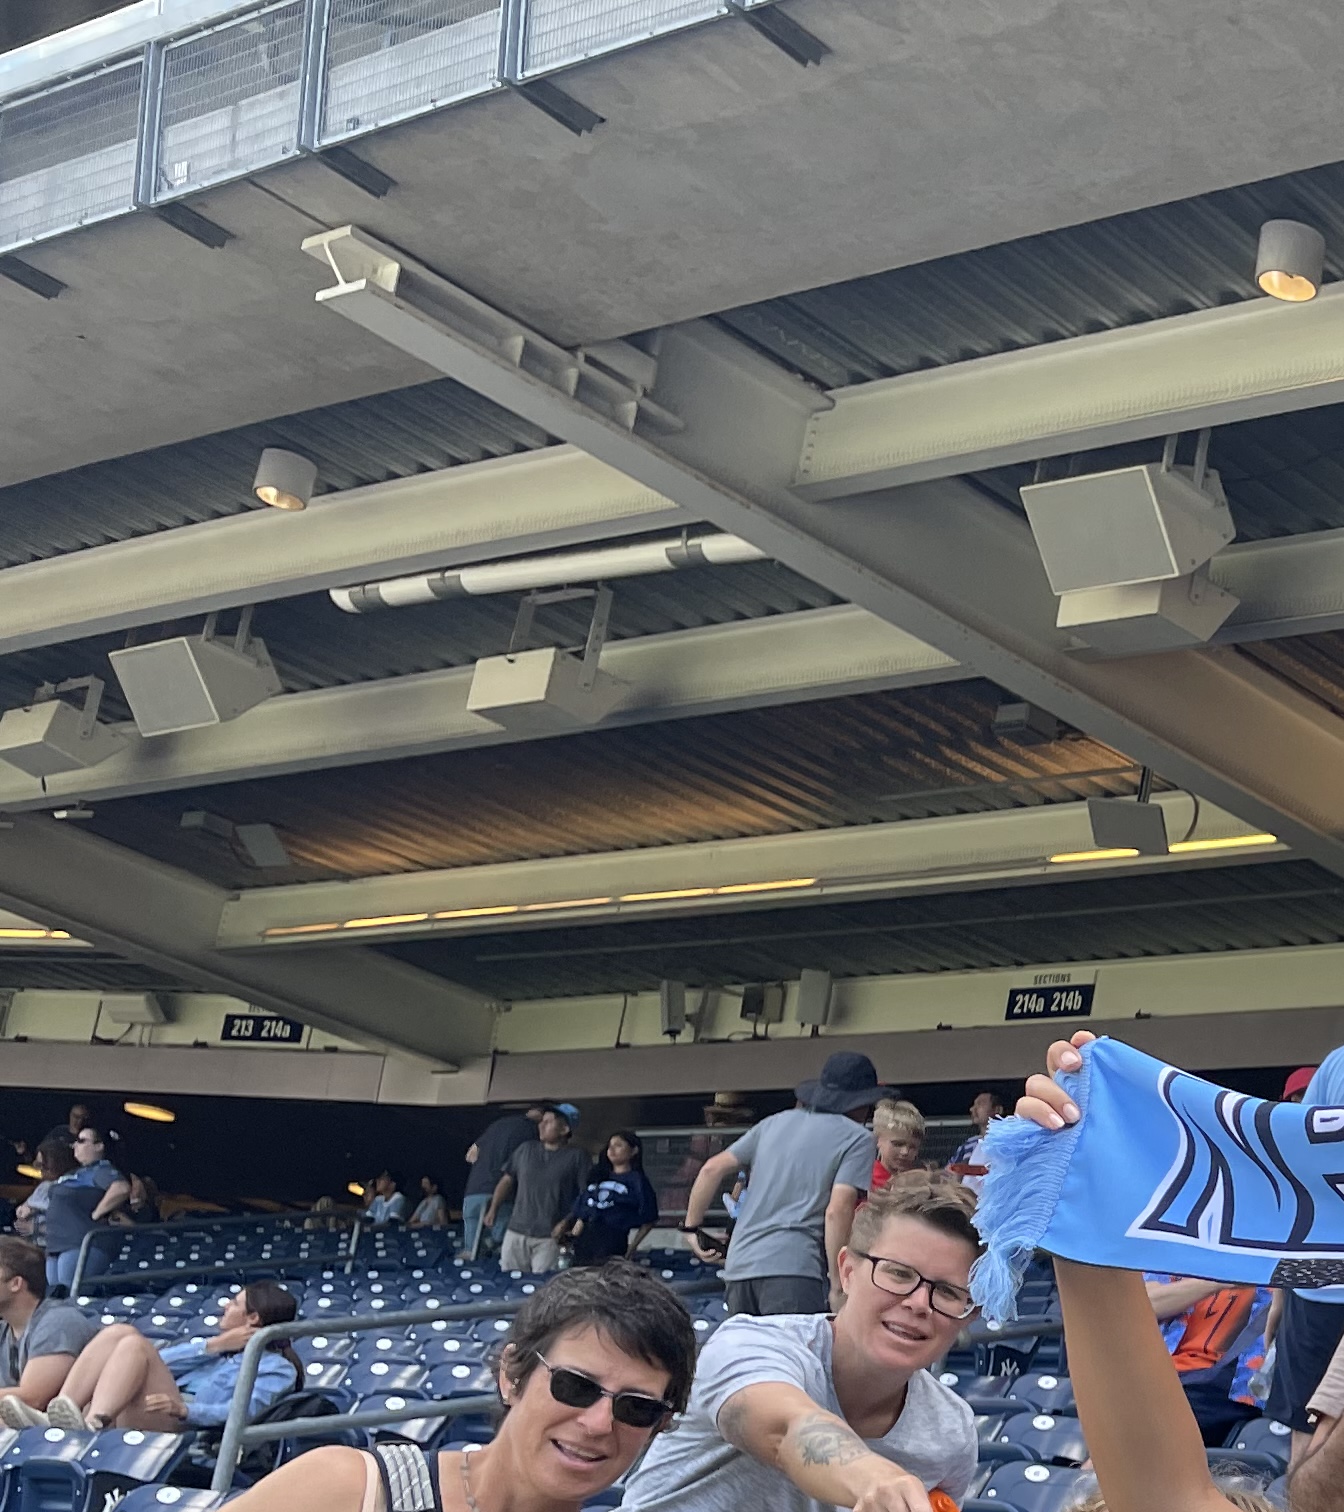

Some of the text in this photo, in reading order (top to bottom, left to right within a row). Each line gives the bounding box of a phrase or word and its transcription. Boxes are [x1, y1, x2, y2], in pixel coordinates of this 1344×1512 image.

[1033, 973, 1071, 985] SECTIONS
[1013, 989, 1083, 1015] 214a 214b
[230, 1018, 254, 1037] 213
